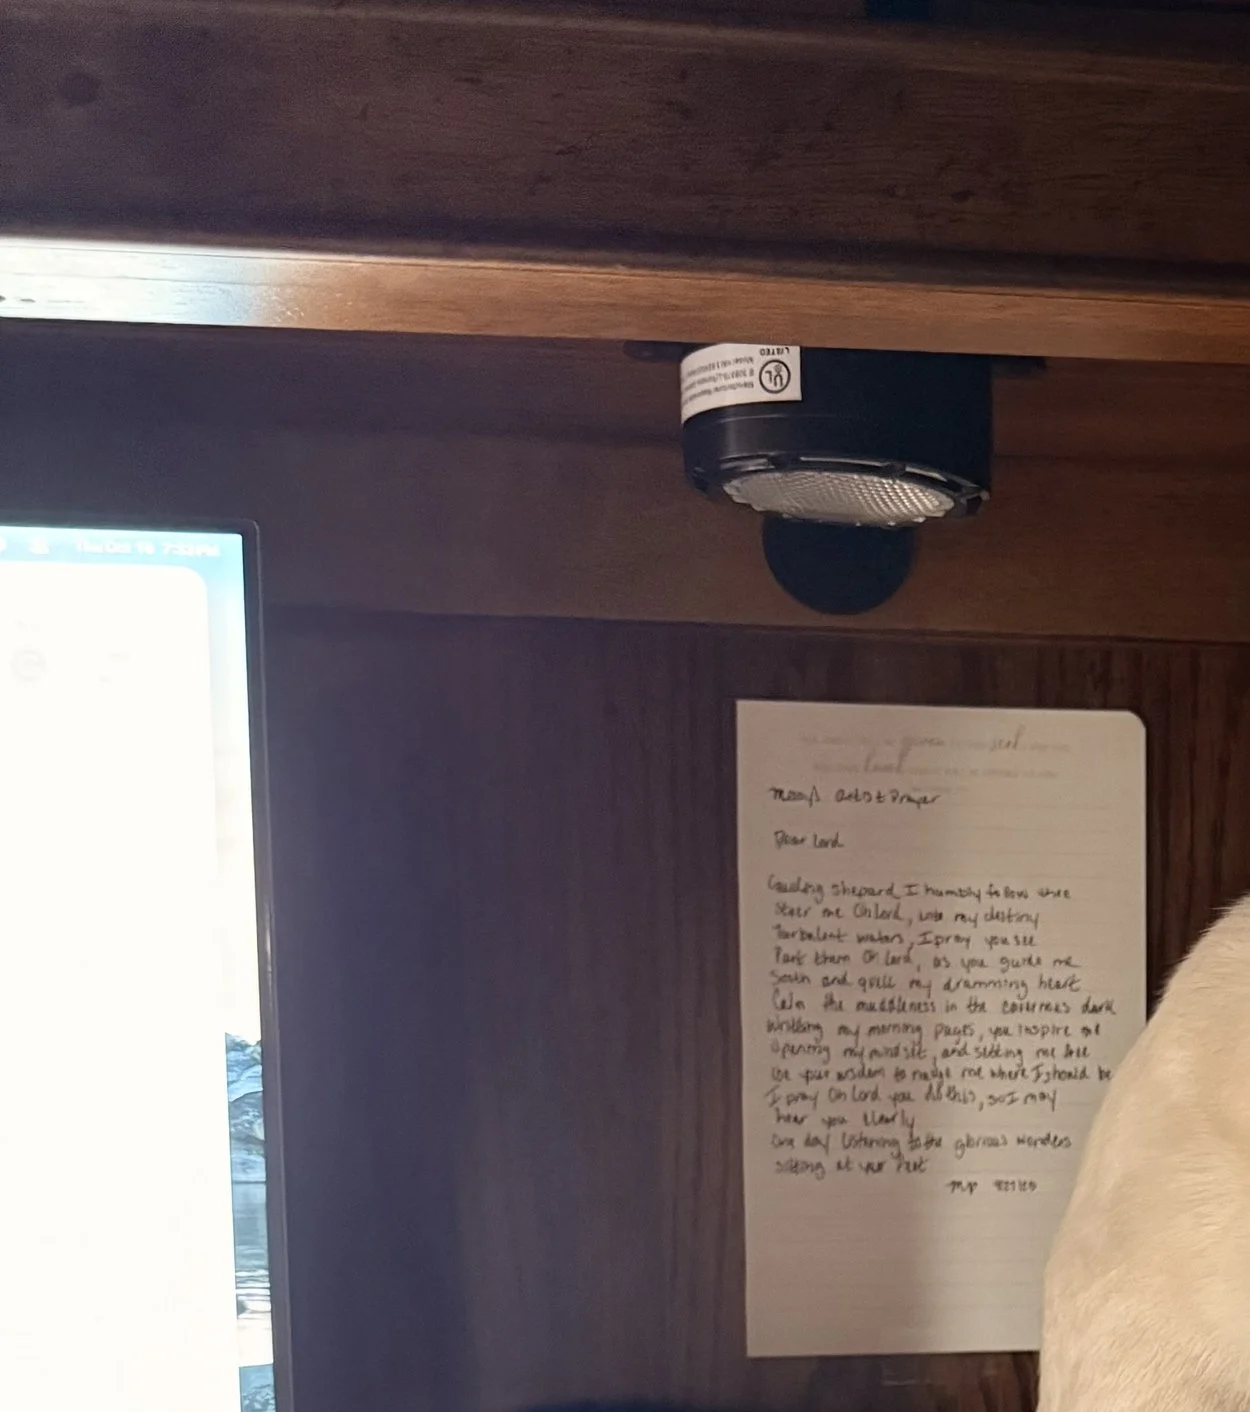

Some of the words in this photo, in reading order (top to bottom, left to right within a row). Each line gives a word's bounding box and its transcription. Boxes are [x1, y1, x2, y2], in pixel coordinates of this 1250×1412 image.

[924, 882, 981, 903] humbly
[985, 882, 1029, 900] follow
[822, 907, 845, 919] me
[954, 910, 979, 928] my
[984, 904, 1040, 930] destiny
[984, 934, 1011, 950] you
[1013, 932, 1038, 947] see
[960, 957, 989, 974] you
[1052, 956, 1083, 968] me
[821, 970, 853, 987] and
[909, 977, 932, 999] my
[1038, 974, 1082, 992] heart
[822, 990, 845, 1012] the
[944, 999, 958, 1013] in
[966, 996, 988, 1014] the
[836, 1023, 861, 1048] my
[867, 1023, 923, 1047] morning
[988, 1026, 1013, 1040] you
[842, 1046, 864, 1064] my
[941, 1043, 970, 1059] and
[1034, 1046, 1057, 1059] me
[960, 1065, 985, 1081] me
[989, 1065, 1029, 1082] where
[786, 1091, 820, 1112] pray
[887, 1092, 916, 1109] you
[1022, 1090, 1057, 1112] may
[775, 1107, 808, 1126] hear
[820, 1115, 848, 1131] you
[803, 1132, 831, 1156] day
[954, 1133, 1008, 1160] glorious
